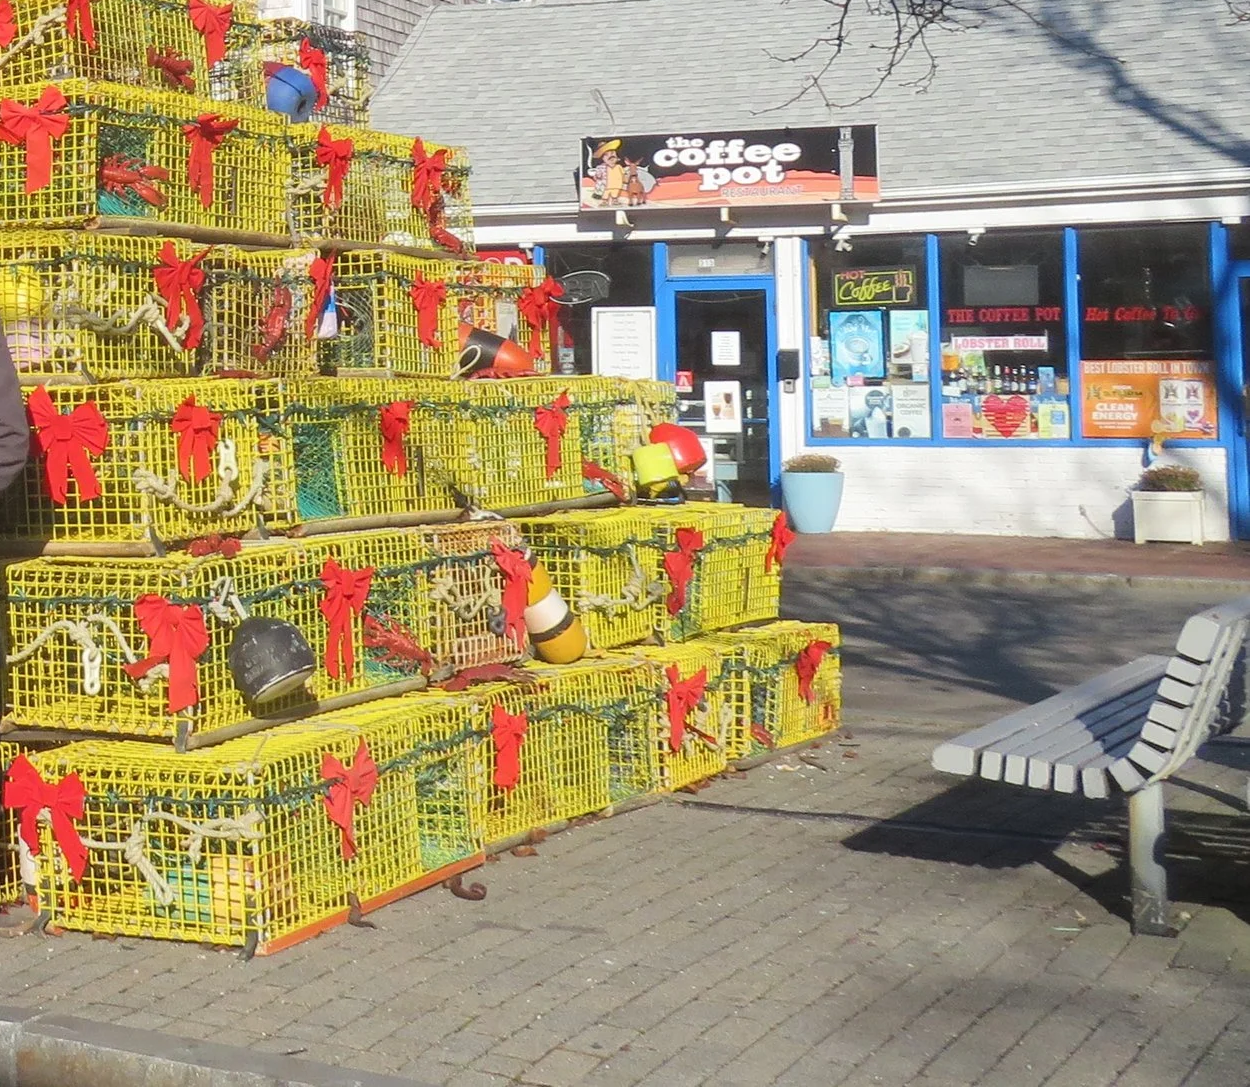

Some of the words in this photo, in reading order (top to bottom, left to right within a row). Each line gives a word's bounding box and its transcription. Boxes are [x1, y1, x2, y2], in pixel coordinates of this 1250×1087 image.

[666, 136, 703, 149] the
[653, 138, 801, 167] coffee
[699, 160, 785, 190] pot
[721, 184, 803, 197] RESTAURANT
[841, 270, 865, 280] HOT
[839, 277, 892, 301] Coffee
[947, 309, 974, 322] THE
[978, 308, 1029, 322] COFFEE
[1034, 307, 1061, 321] POT
[954, 337, 1009, 349] LOBSTER
[1013, 337, 1045, 349] ROLL
[1084, 362, 1105, 374] BEST
[1107, 362, 1144, 374] LOBSTER
[1147, 362, 1170, 374] ROLL
[1170, 362, 1181, 373] IN
[1095, 403, 1134, 412] CLEAN
[1092, 412, 1138, 421] ENERGY
